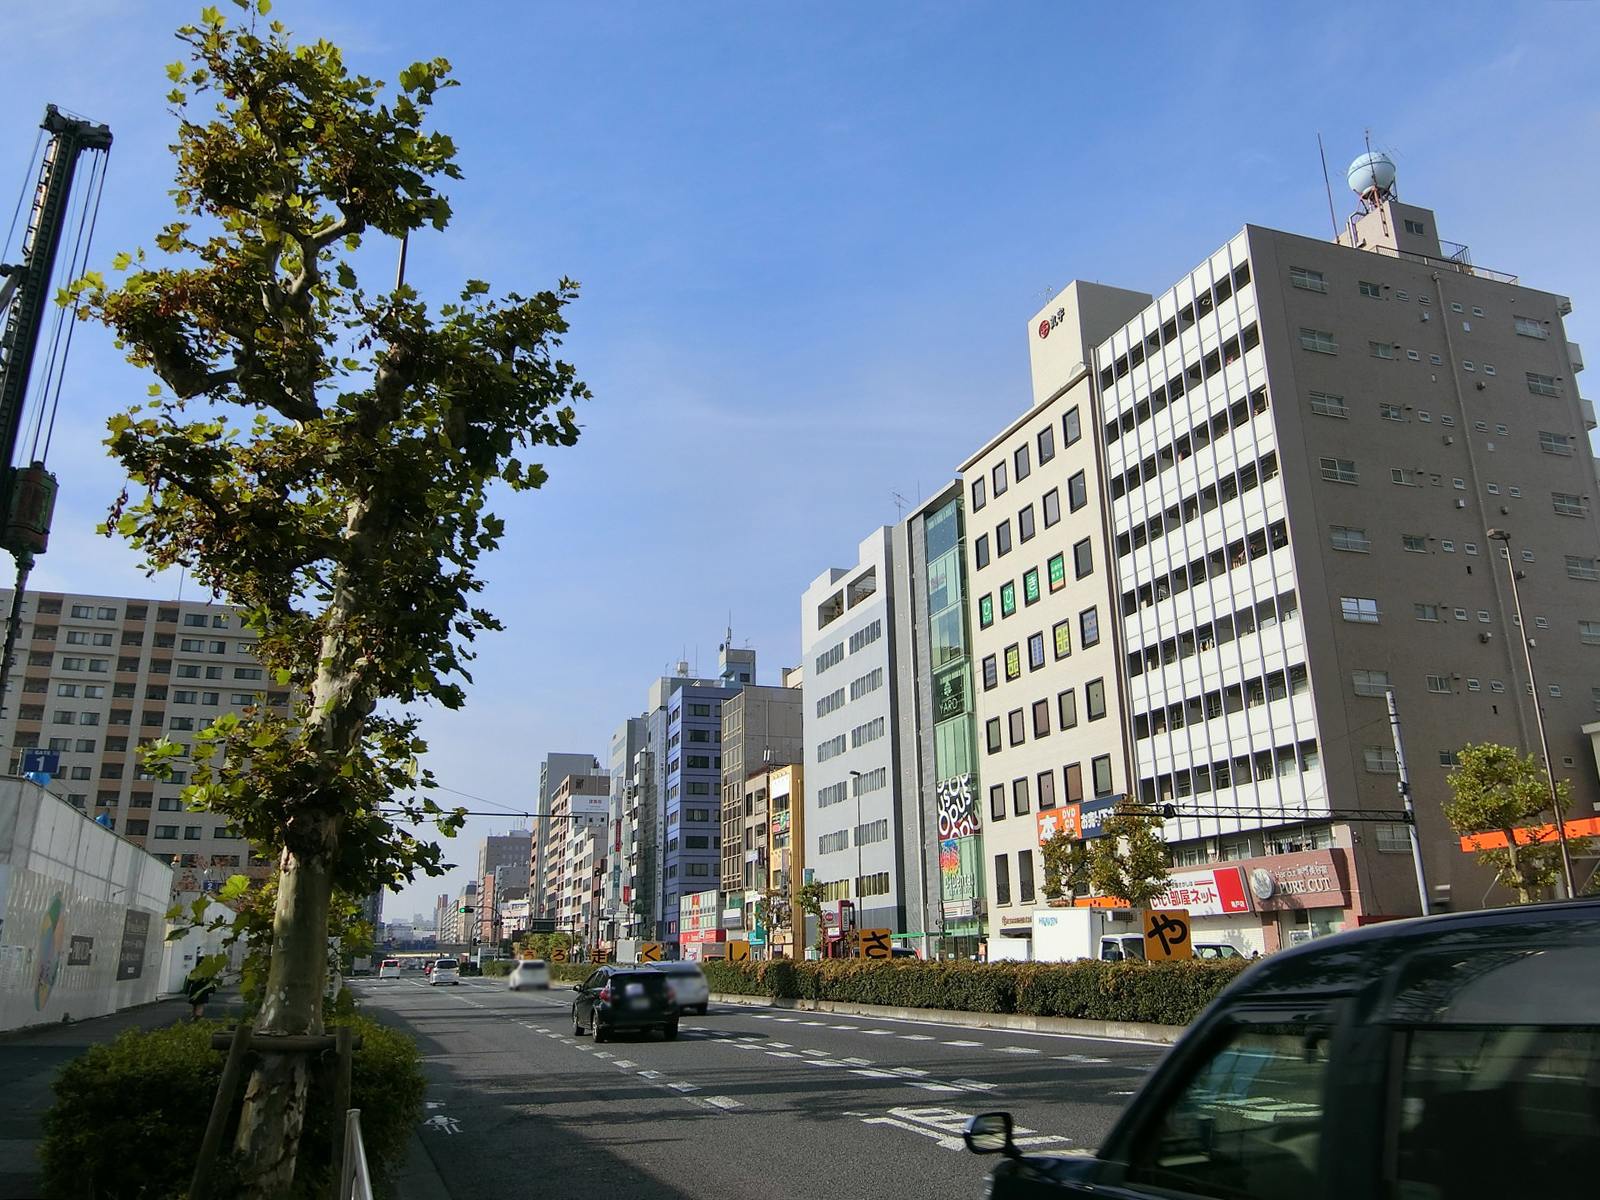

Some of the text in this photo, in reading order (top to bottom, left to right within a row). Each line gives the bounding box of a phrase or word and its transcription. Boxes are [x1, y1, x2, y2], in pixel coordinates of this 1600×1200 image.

[36, 755, 46, 772] 1
[1062, 807, 1076, 819] DVD
[1039, 815, 1057, 840] 本
[1064, 818, 1075, 828] CD
[1278, 877, 1332, 894] PURE CUT
[1150, 887, 1217, 908] いい部屋ネット
[1147, 914, 1188, 956] や
[862, 930, 889, 959] さ
[553, 949, 565, 961] ろ
[591, 949, 607, 964] 走
